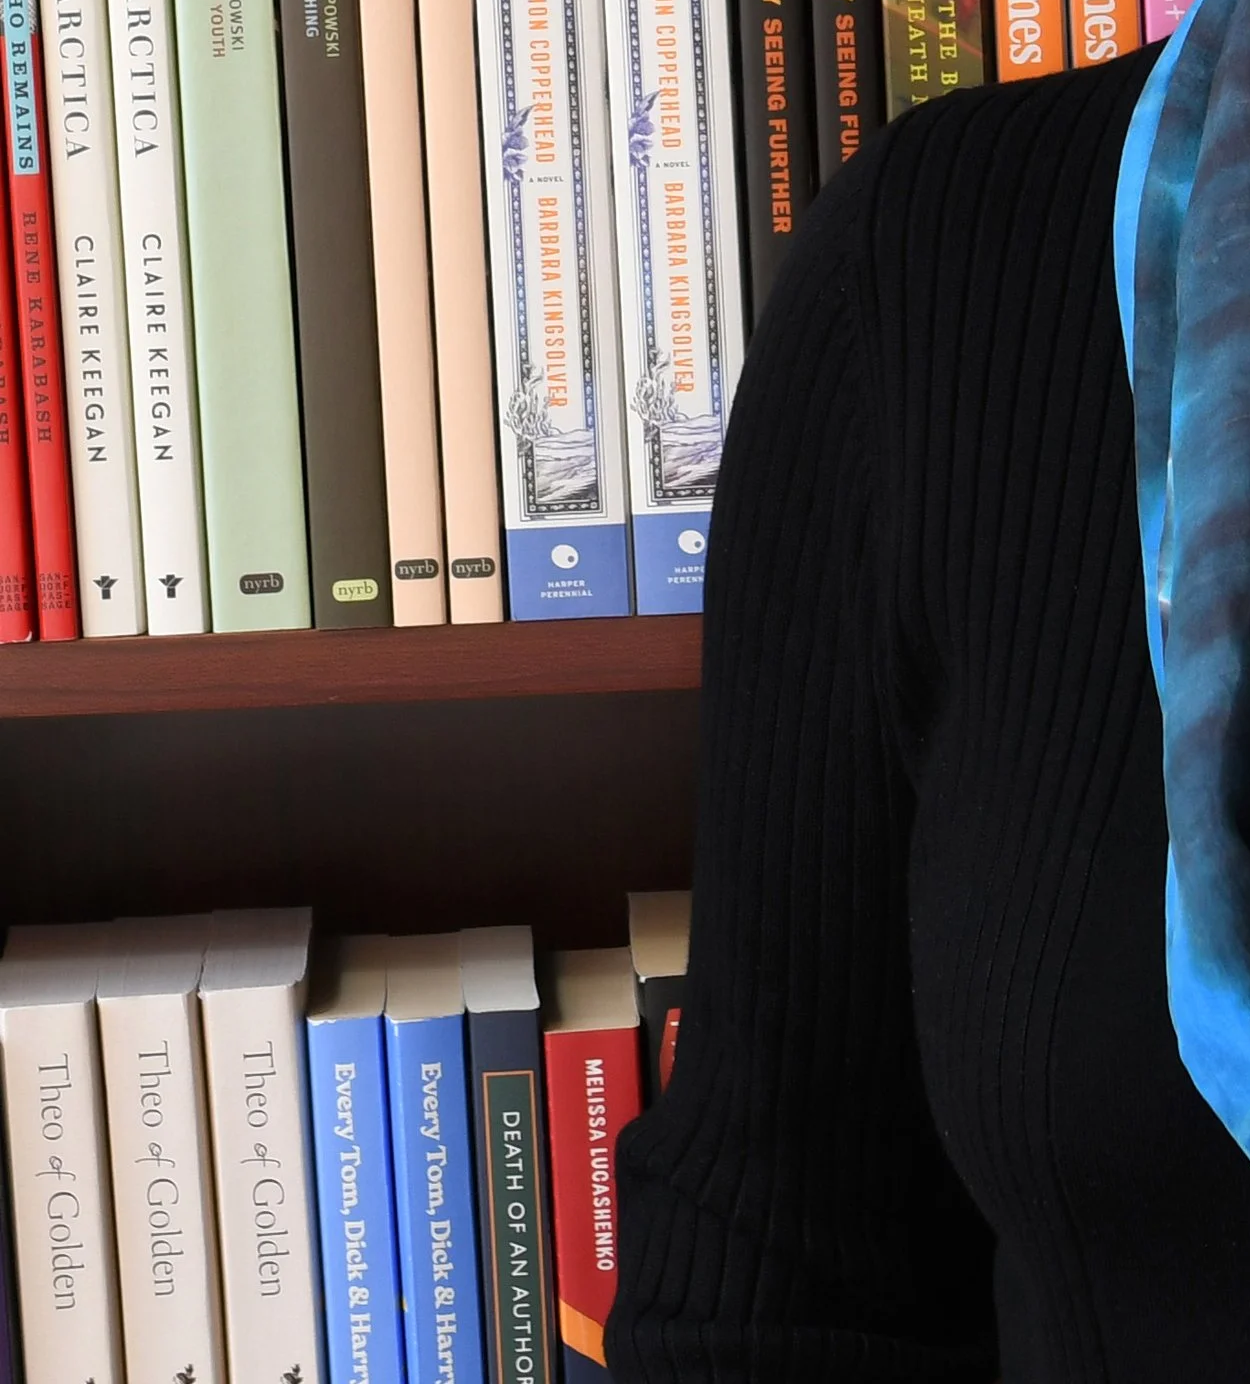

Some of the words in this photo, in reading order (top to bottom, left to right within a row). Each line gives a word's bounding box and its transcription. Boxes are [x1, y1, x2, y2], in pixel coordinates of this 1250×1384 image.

[210, 3, 225, 58] YOUTH
[763, 18, 786, 112] SEEING
[12, 41, 35, 171] REMAINS
[530, 39, 555, 164] COPPERHEAD
[768, 118, 792, 234] FURTHER
[538, 197, 561, 282] BARBARA
[74, 235, 99, 335] CLAIRE
[543, 289, 568, 409] KINGSOLVER
[81, 349, 108, 463] KEEGAN
[244, 575, 280, 593] nyrb
[400, 560, 434, 577] nyrb
[540, 589, 593, 599] PERENNIAL
[547, 580, 586, 589] HARPER
[37, 1053, 73, 1142] Theo
[333, 1063, 356, 1141] Every
[585, 1058, 606, 1143] MELISSA
[35, 1154, 75, 1180] of
[335, 1145, 362, 1215] Tom,
[502, 1111, 524, 1191] DEATH
[507, 1202, 526, 1234] OF
[590, 1147, 615, 1272] LUCASHENKO
[46, 1190, 84, 1312] Golden
[344, 1220, 368, 1281] Dick
[508, 1242, 528, 1277] AN
[348, 1286, 369, 1308] &
